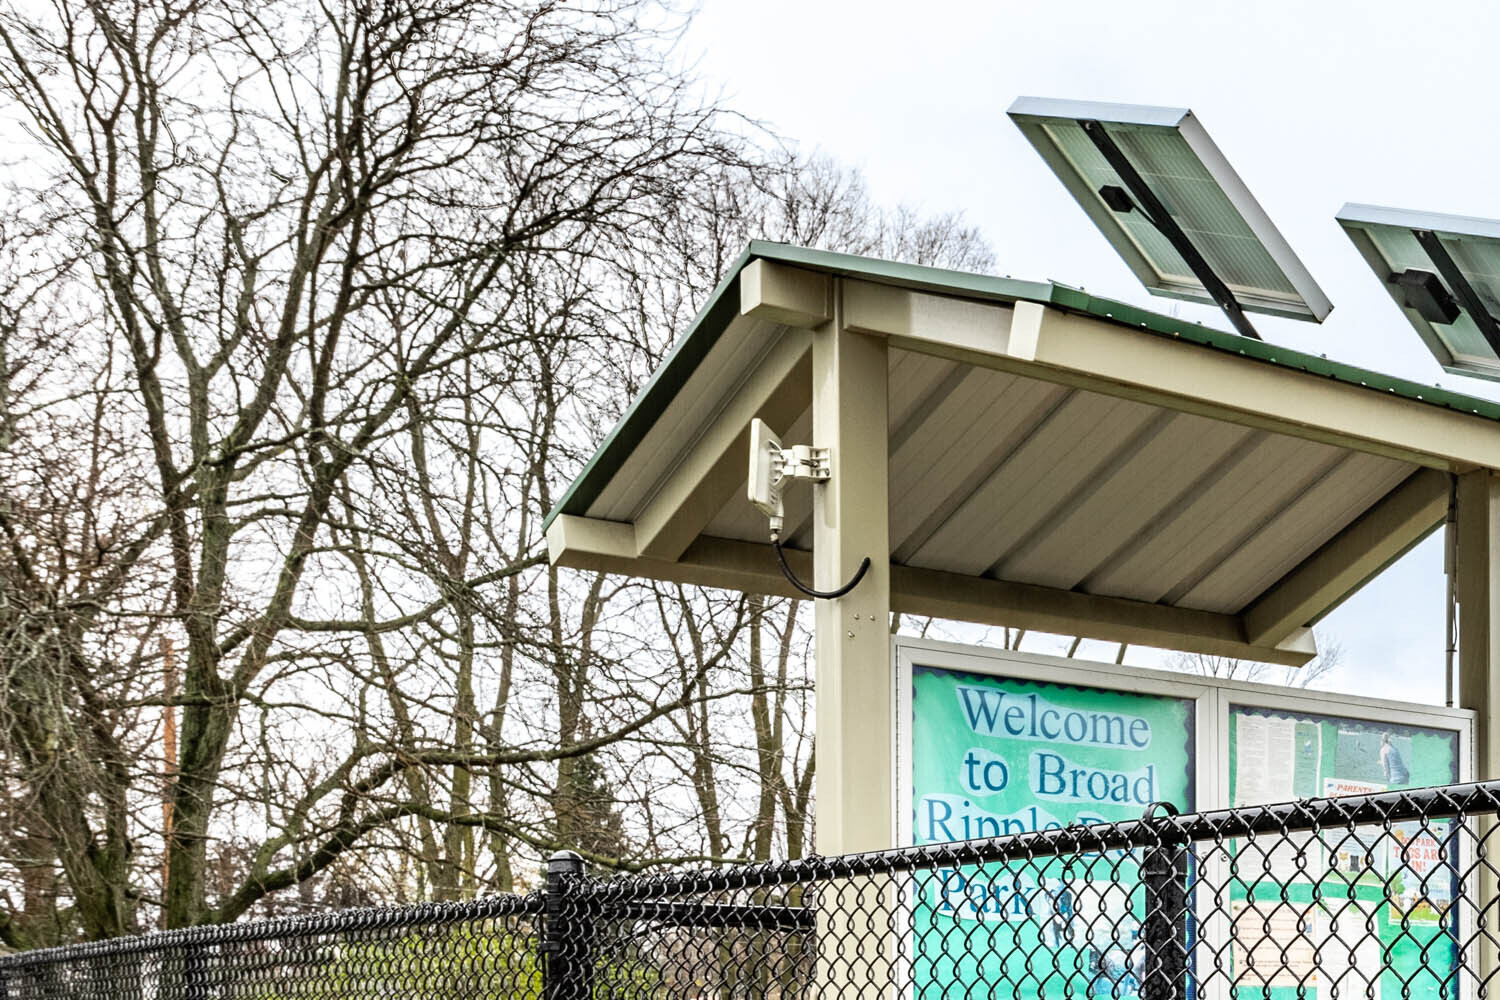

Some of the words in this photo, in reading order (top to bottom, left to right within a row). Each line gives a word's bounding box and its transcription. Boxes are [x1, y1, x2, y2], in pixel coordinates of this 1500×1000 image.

[958, 688, 1150, 748] Welcome
[964, 752, 1008, 791] to
[1036, 753, 1154, 805] Broad
[940, 869, 1036, 915] Park
